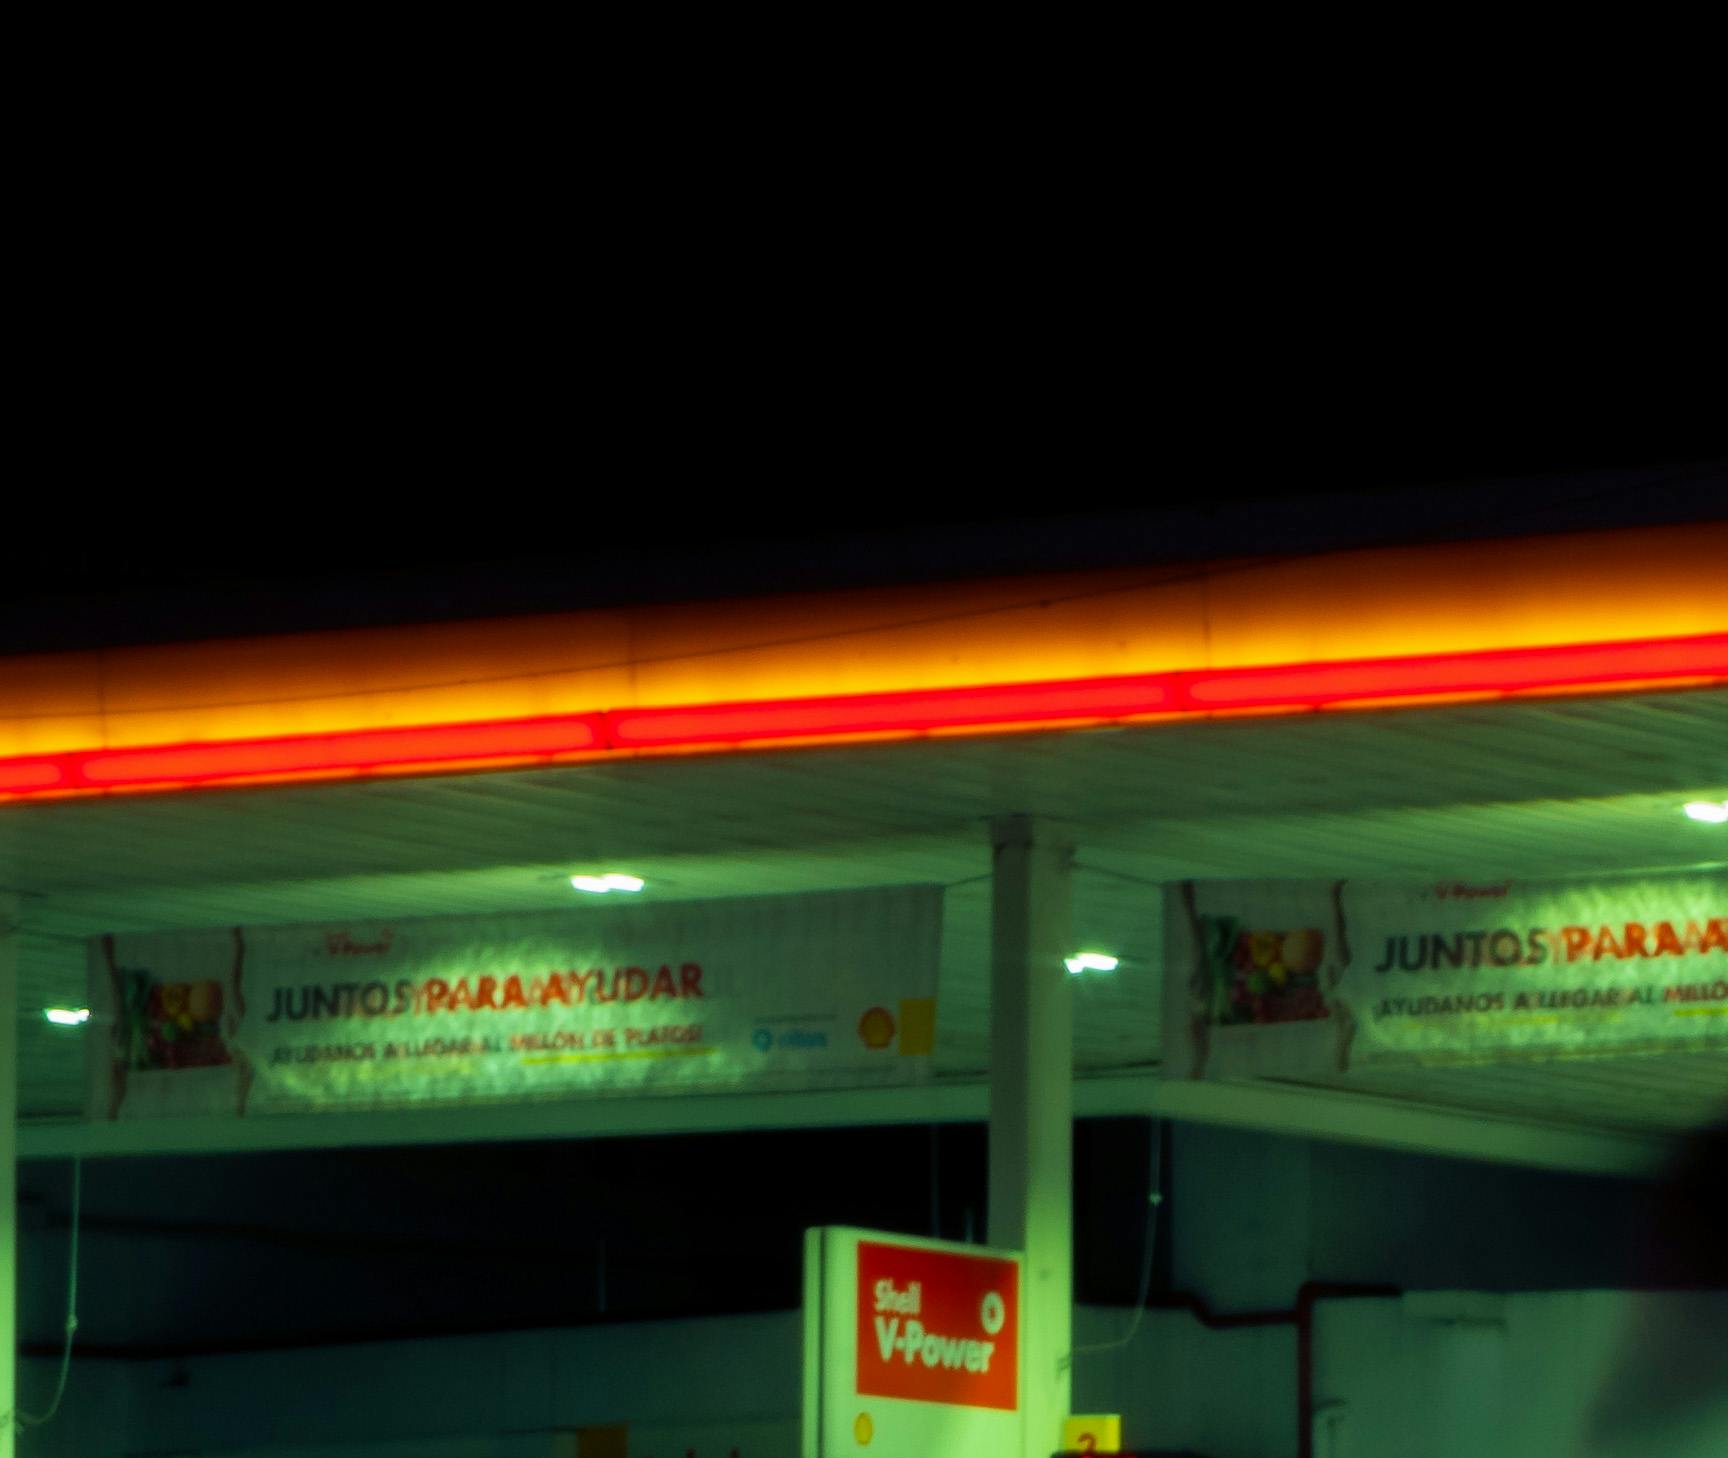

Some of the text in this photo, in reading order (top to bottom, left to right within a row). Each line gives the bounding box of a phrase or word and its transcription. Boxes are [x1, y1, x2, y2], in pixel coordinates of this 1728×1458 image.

[1375, 928, 1548, 974] JUNTOS
[1562, 922, 1684, 967] PARA
[266, 962, 704, 1022] JUNTOS PARA AYUDAR
[874, 1278, 922, 1315] Shell
[874, 1315, 995, 1374] V-Power
